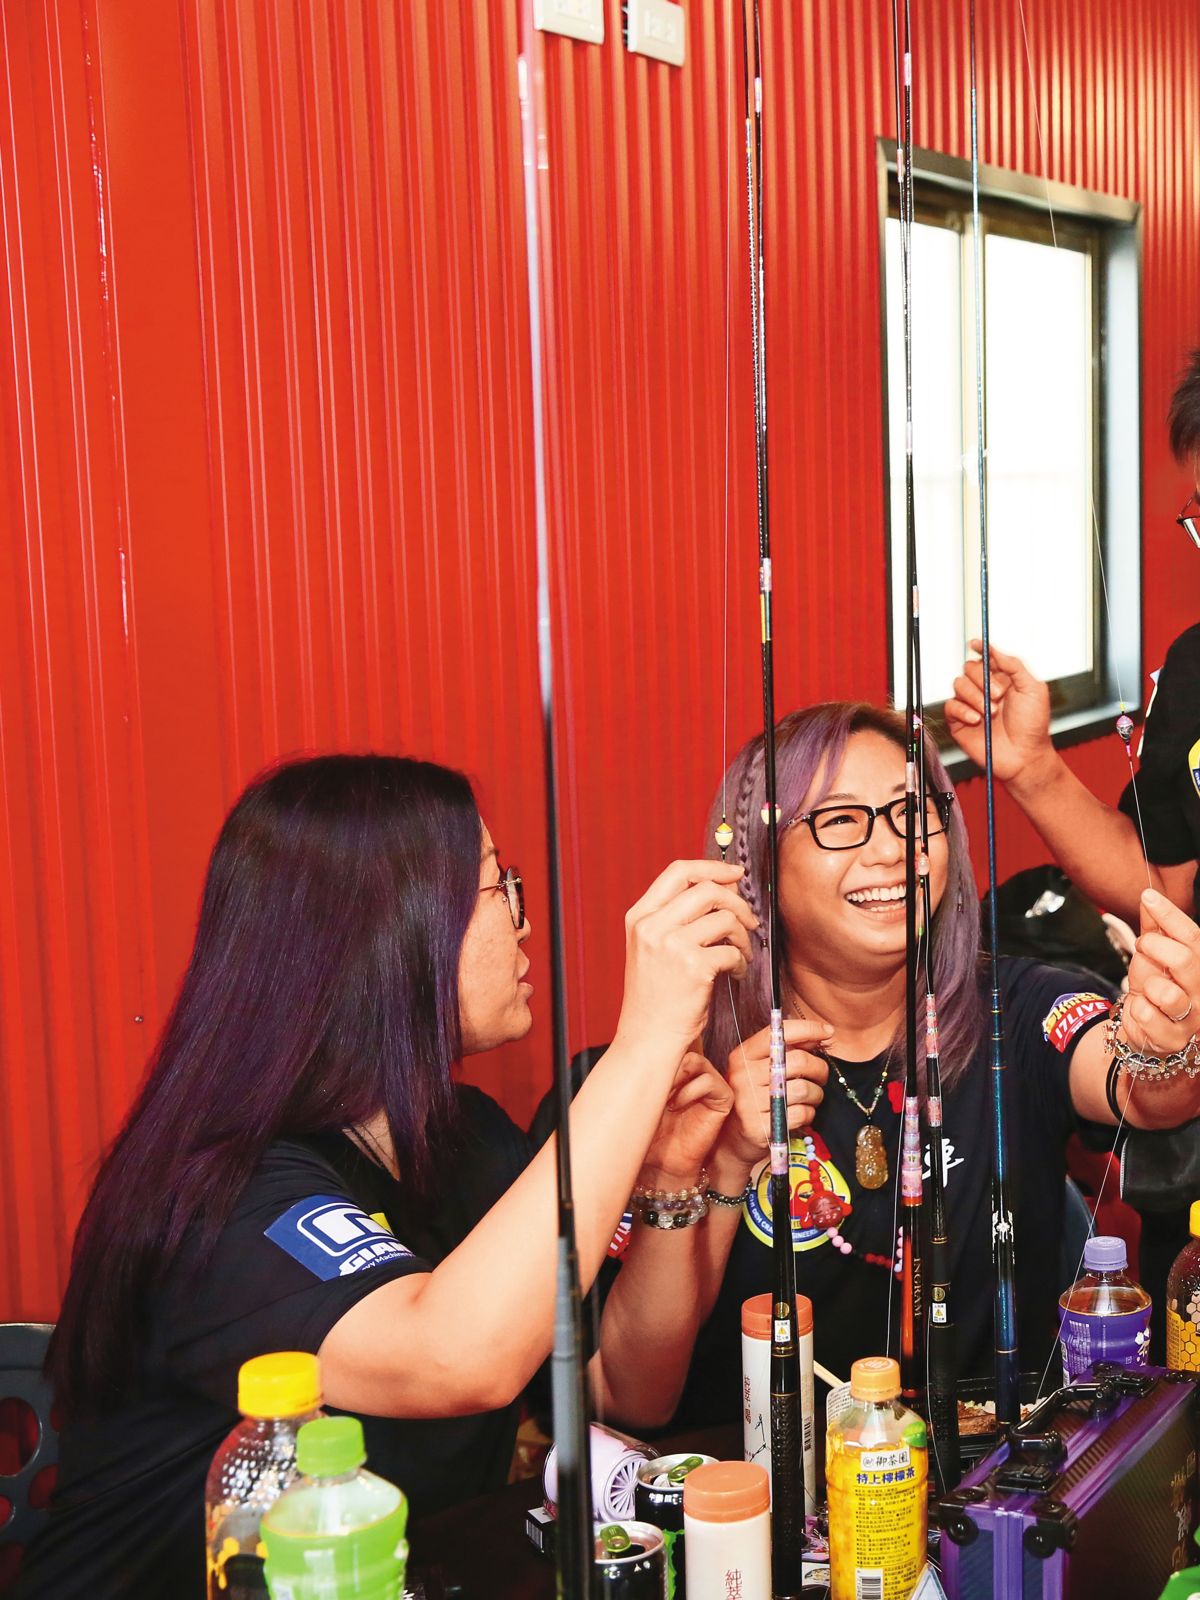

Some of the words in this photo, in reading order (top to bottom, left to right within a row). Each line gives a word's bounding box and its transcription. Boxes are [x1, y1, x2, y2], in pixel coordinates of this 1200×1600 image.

[1055, 1001, 1109, 1039] 17LIVE
[913, 1258, 923, 1317] INGRAM
[856, 1466, 916, 1485] 特上檸檬茶
